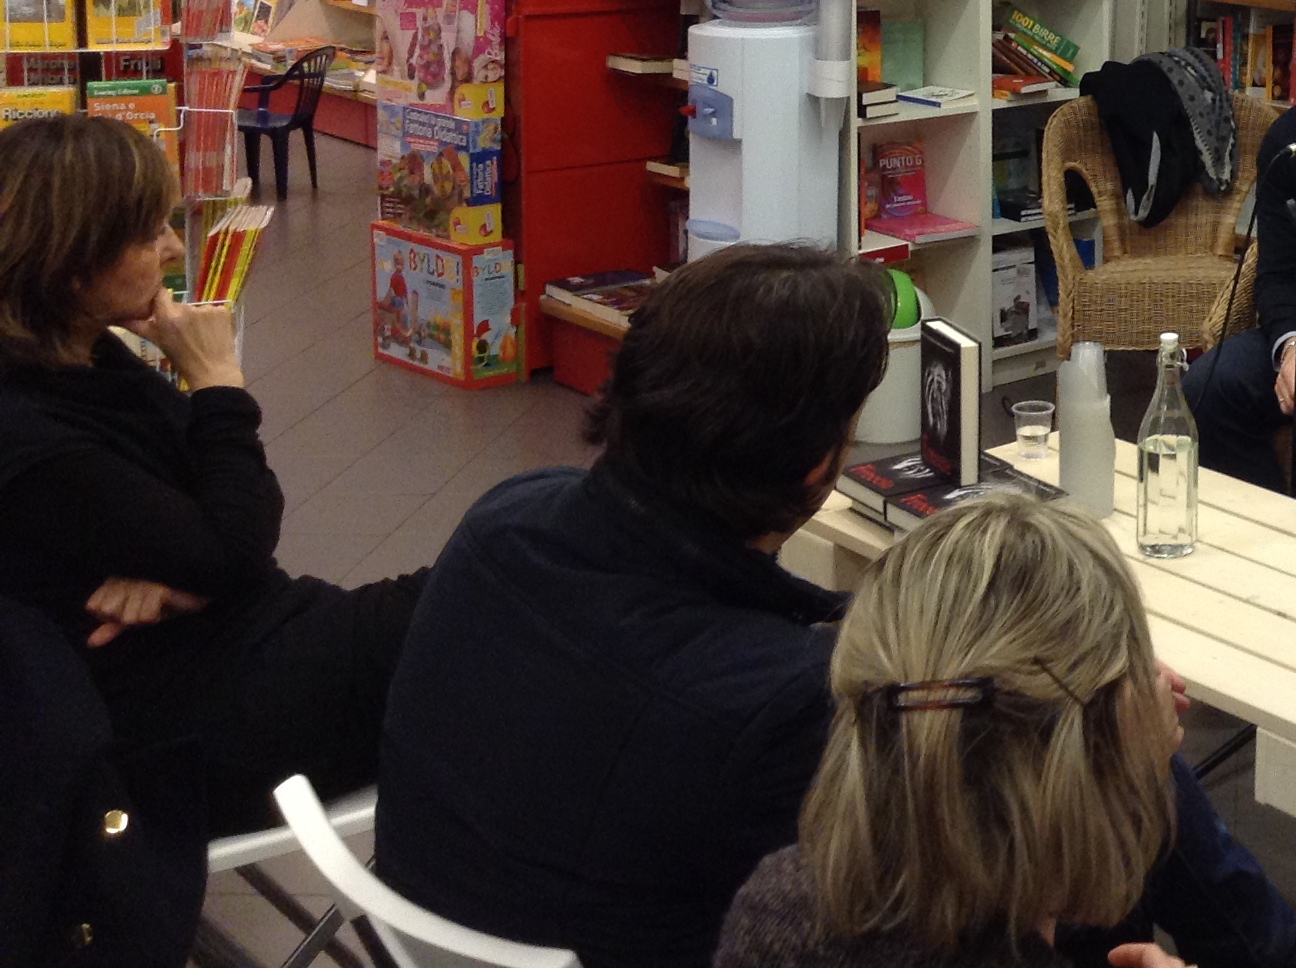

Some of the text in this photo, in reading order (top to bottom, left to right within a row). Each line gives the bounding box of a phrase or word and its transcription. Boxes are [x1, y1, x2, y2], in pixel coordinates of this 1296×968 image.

[1011, 10, 1035, 30] 1001
[93, 102, 127, 112] Siena
[879, 155, 923, 170] PUNTO G
